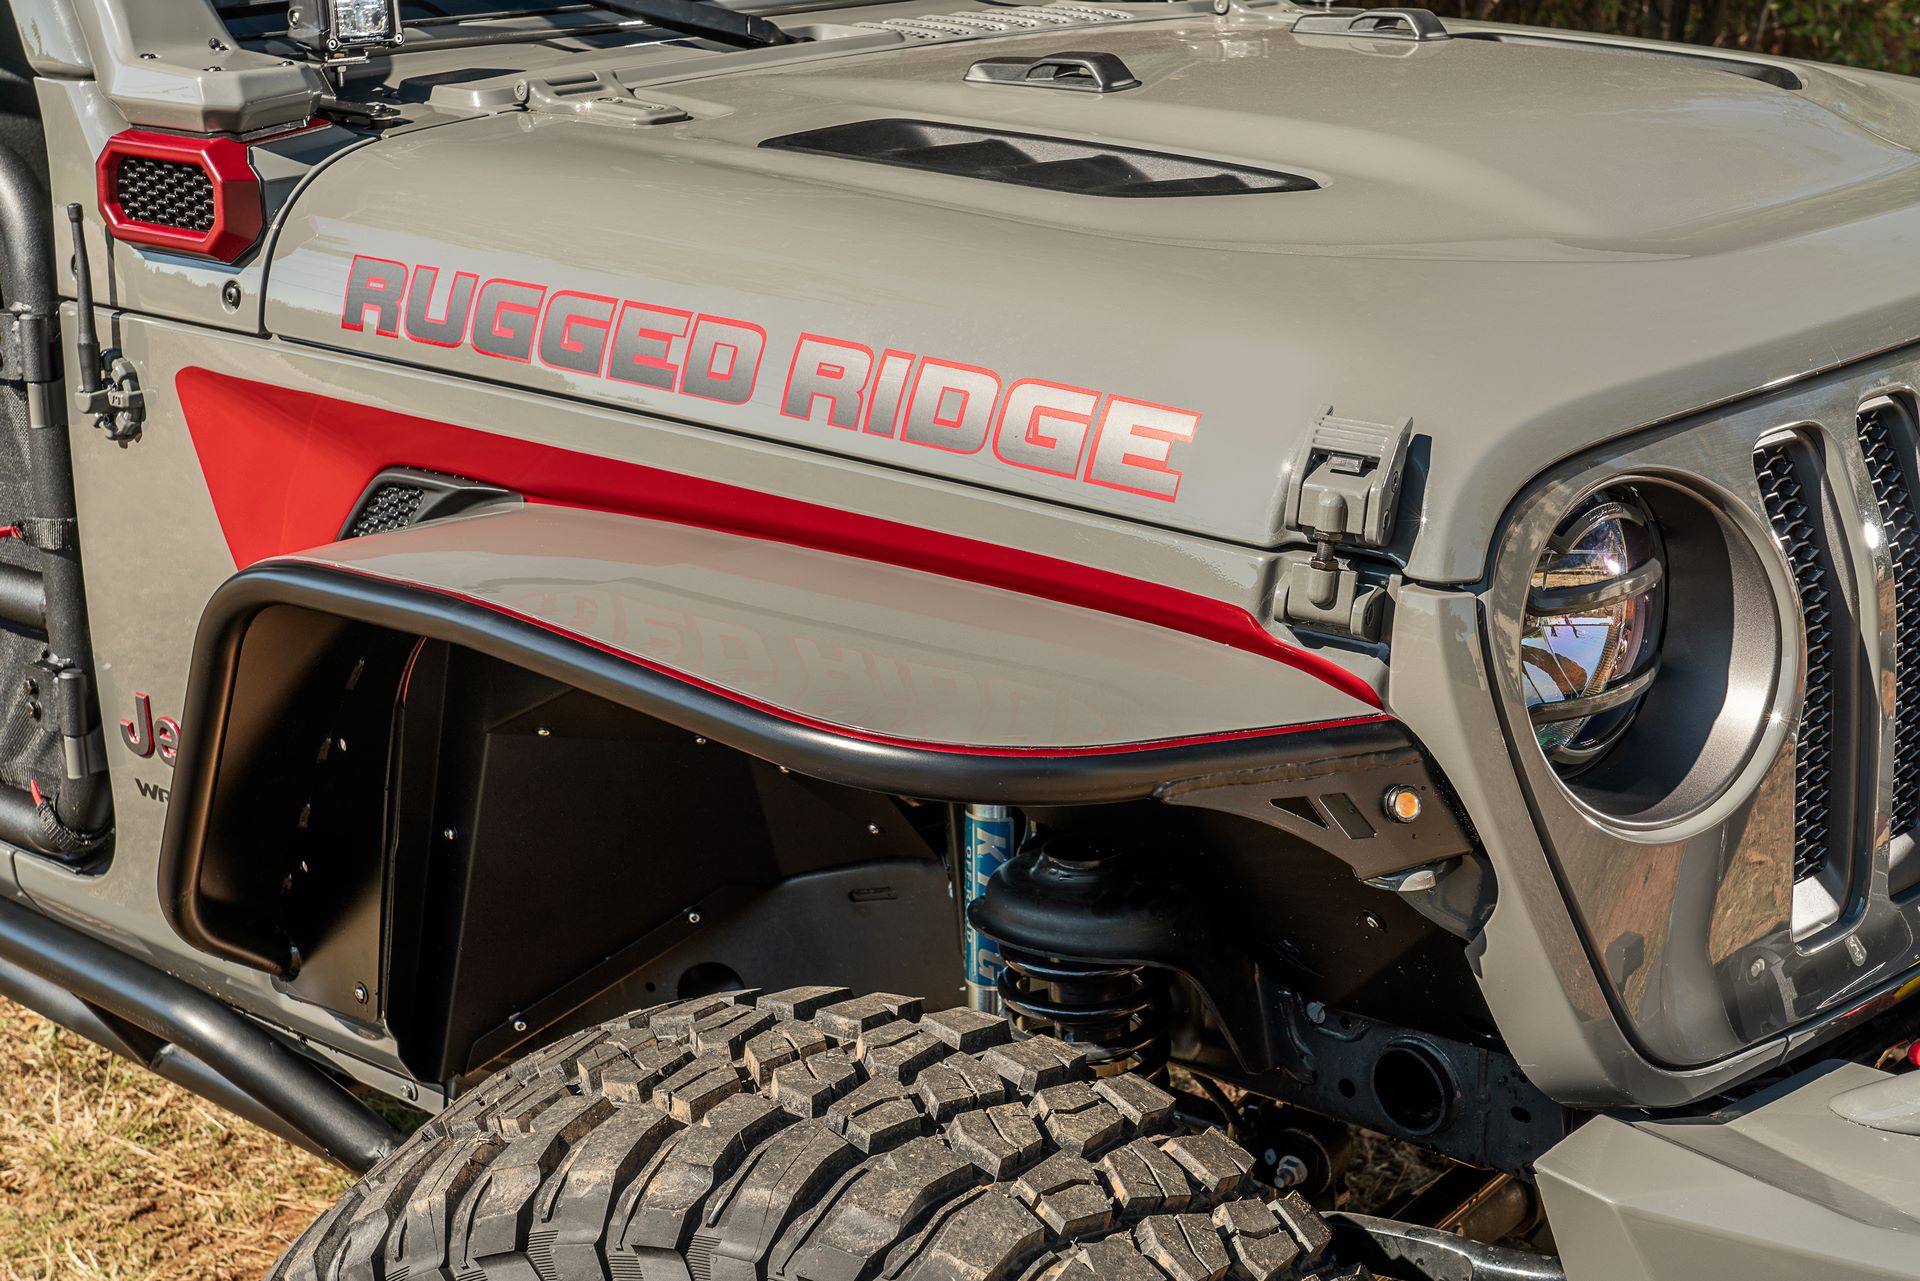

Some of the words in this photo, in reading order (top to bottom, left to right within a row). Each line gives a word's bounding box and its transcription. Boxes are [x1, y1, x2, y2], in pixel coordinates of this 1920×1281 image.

[341, 254, 768, 406] RUGGED
[780, 332, 1202, 504] RIDGE
[120, 691, 182, 768] Je
[134, 777, 171, 803] WR
